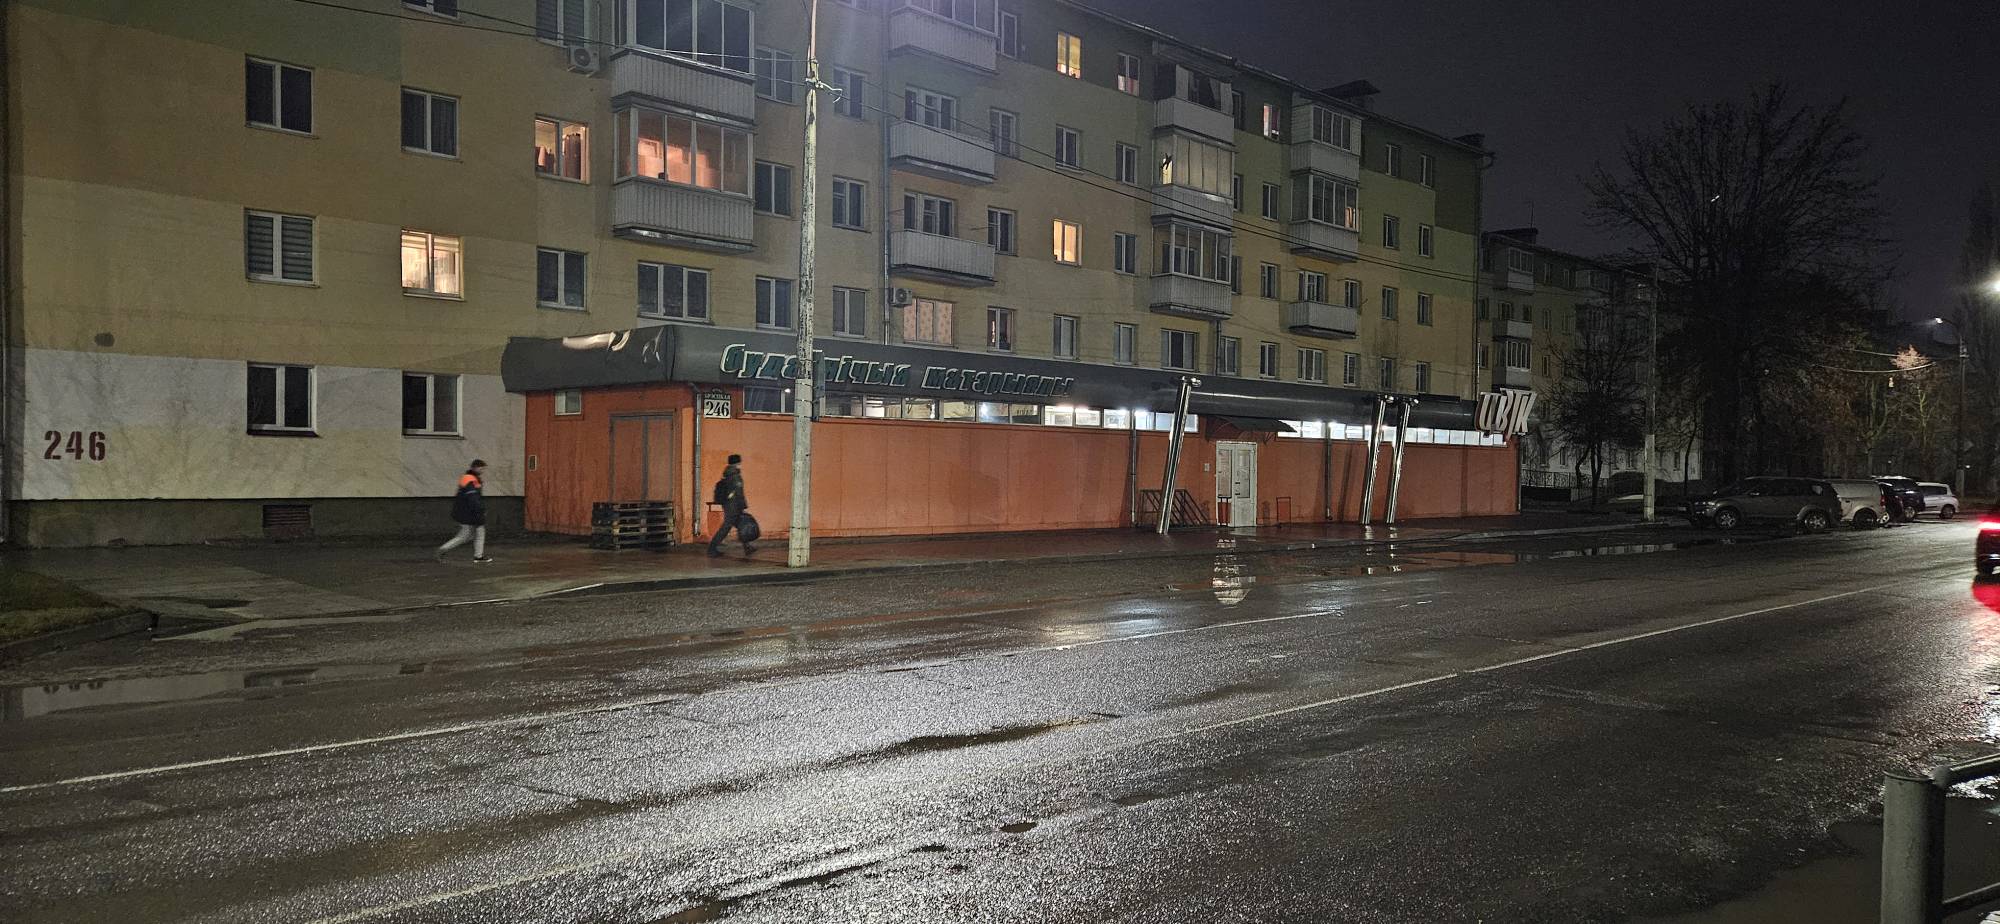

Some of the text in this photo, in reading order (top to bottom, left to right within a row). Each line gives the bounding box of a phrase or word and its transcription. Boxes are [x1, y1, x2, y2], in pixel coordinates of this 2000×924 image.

[720, 344, 911, 387] буданічыя
[705, 401, 730, 417] 246
[44, 430, 106, 461] 246
